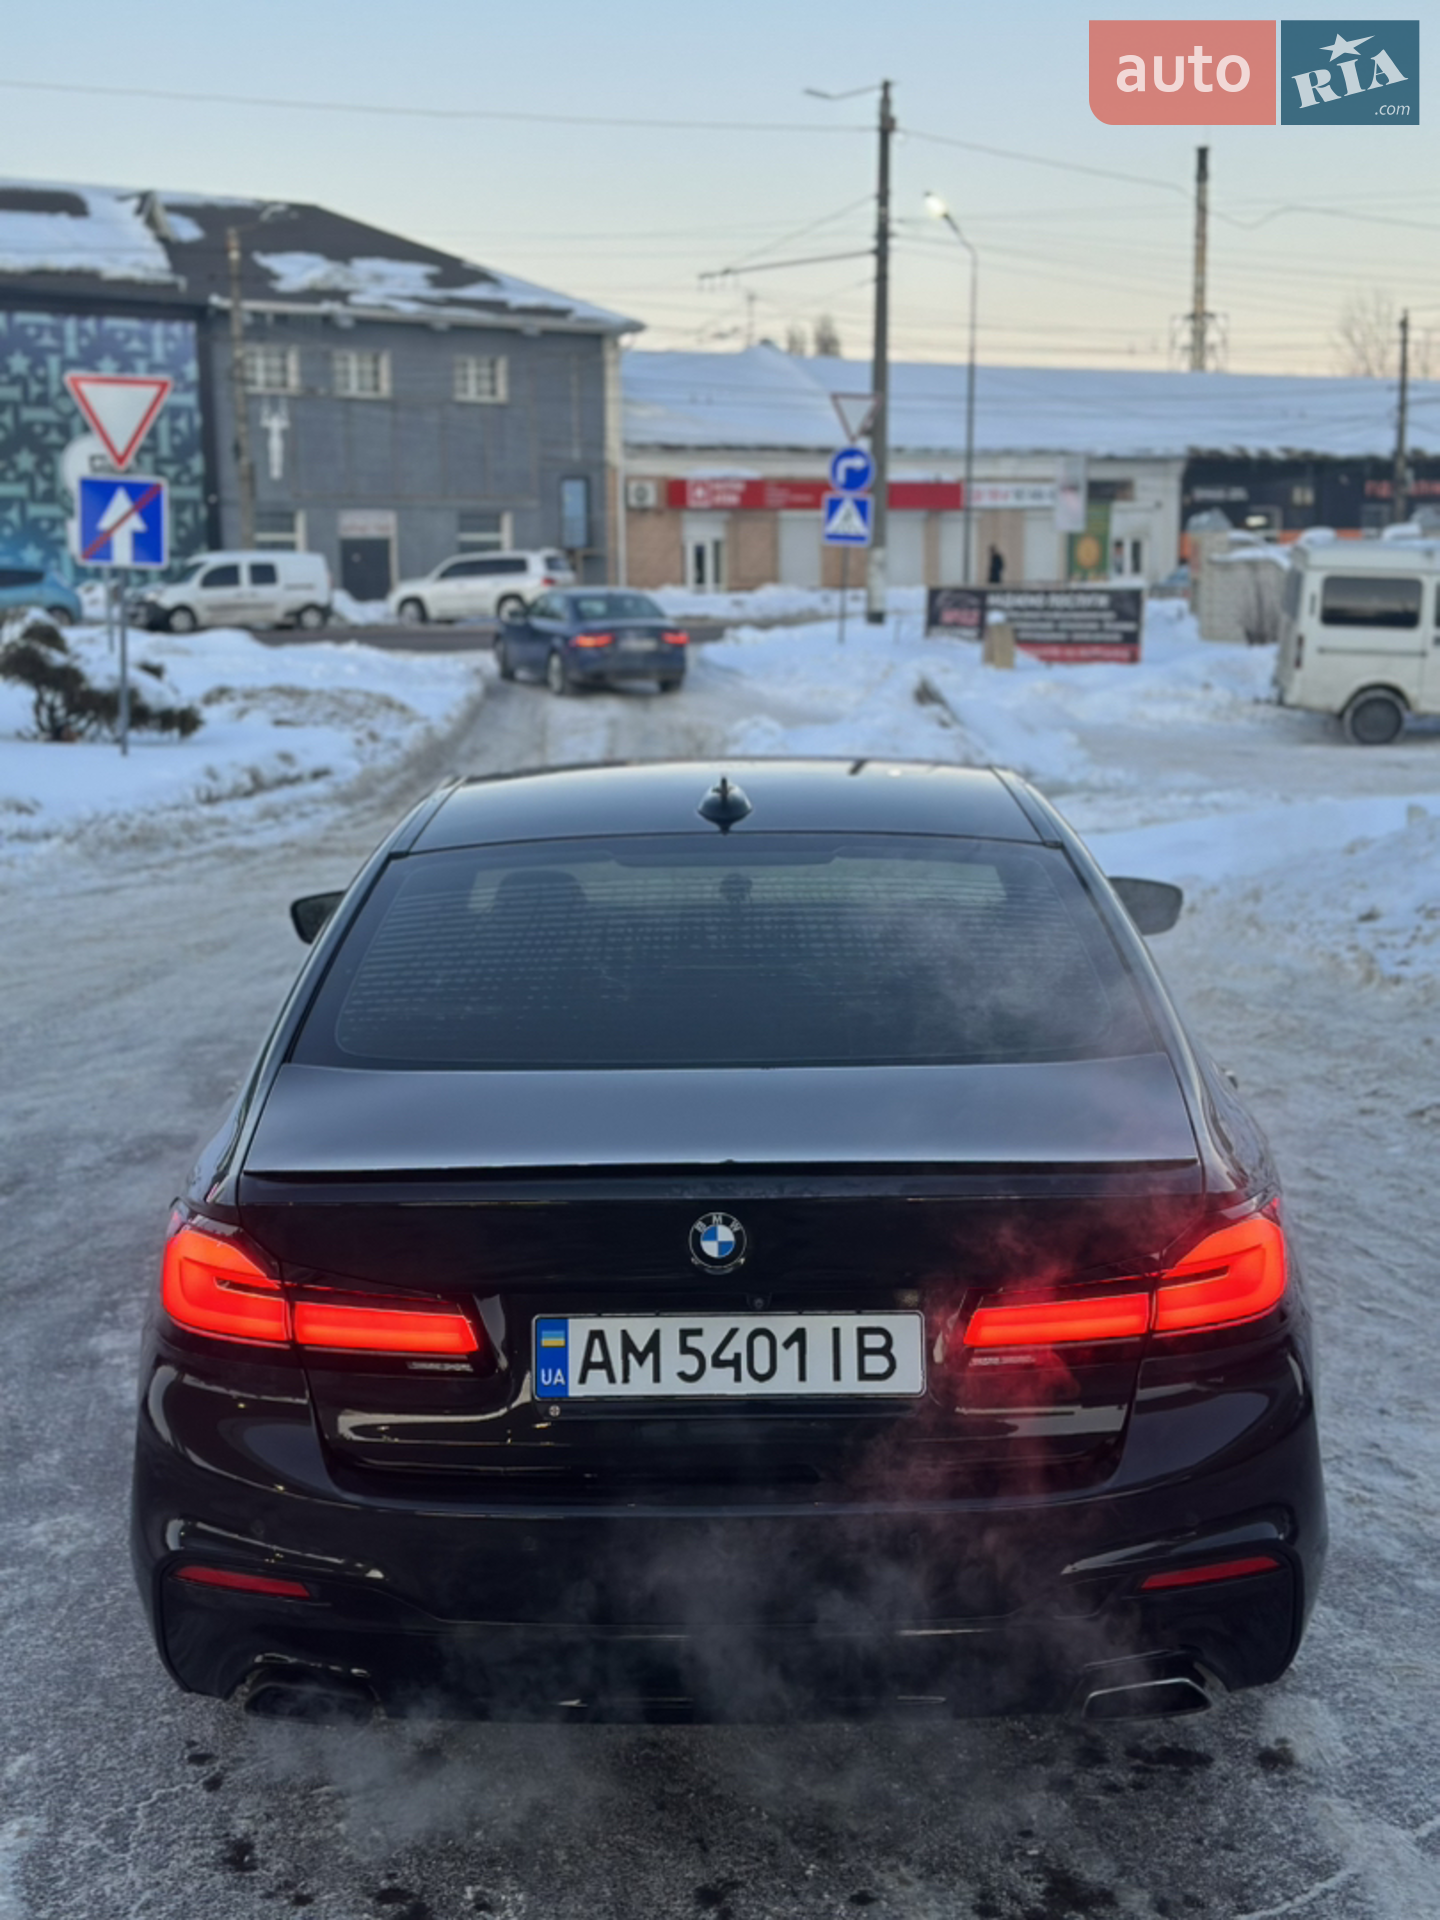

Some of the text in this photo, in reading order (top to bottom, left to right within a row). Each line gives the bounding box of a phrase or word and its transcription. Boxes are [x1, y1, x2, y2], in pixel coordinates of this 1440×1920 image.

[577, 1325, 897, 1385] AM 5401 IB
[540, 1367, 566, 1386] UA
